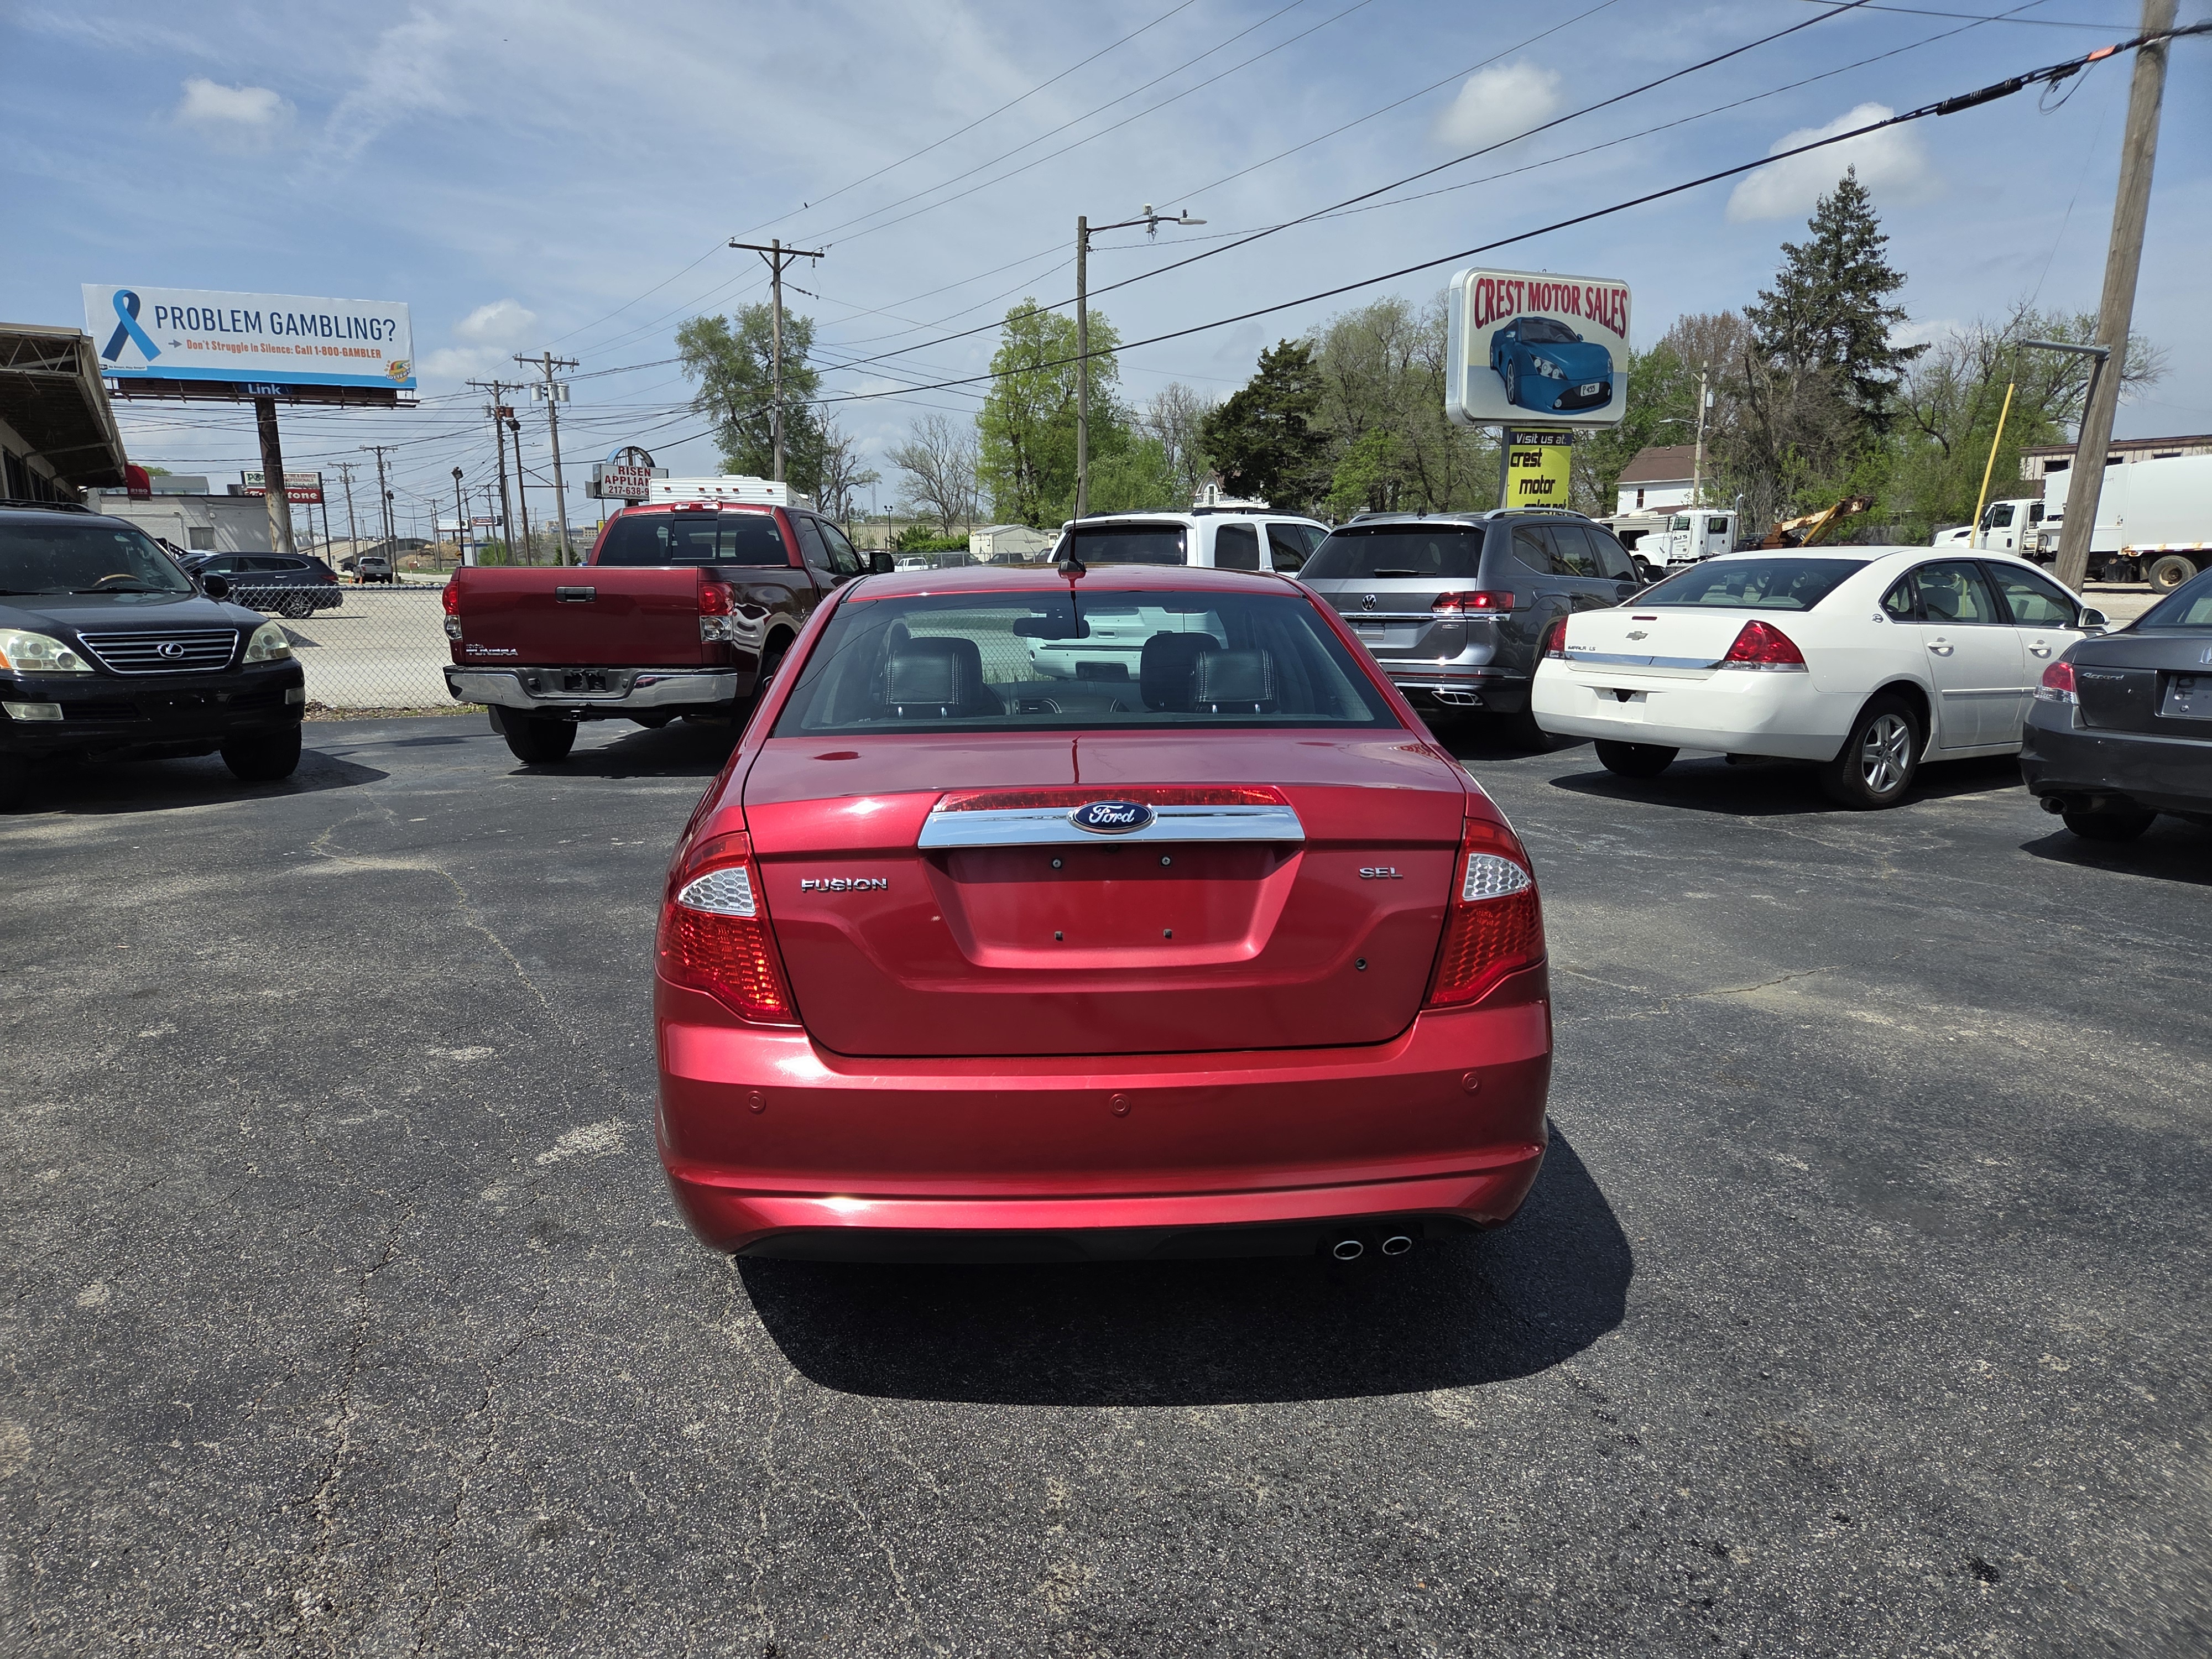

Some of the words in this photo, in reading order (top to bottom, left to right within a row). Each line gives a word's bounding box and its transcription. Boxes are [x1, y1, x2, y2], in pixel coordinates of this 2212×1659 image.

[1474, 278, 1525, 330] CREST
[1528, 281, 1581, 316] MOTOR
[1585, 286, 1627, 340] SALES
[155, 305, 263, 334] PROBLEM
[270, 312, 396, 342] GAMBLING?
[186, 339, 210, 350] Don't
[211, 341, 249, 354] Struggle
[251, 343, 259, 353] in
[260, 343, 294, 354] Silence:
[295, 345, 312, 355] Call
[314, 346, 382, 358] 1-800-GAMBLER
[387, 369, 410, 379] LOTTERY
[248, 383, 282, 395] Link
[1516, 433, 1538, 444] Visit
[1541, 435, 1554, 444] us
[1510, 447, 1543, 467] crest
[618, 466, 651, 477] RISEN
[604, 475, 650, 487] APPLIAN
[1519, 474, 1556, 494] motor
[609, 486, 649, 496] 217-638-9
[2082, 672, 2125, 681] Accord
[1089, 805, 1135, 823] Ford
[1359, 867, 1404, 878] SEL
[801, 878, 887, 891] FUSION
